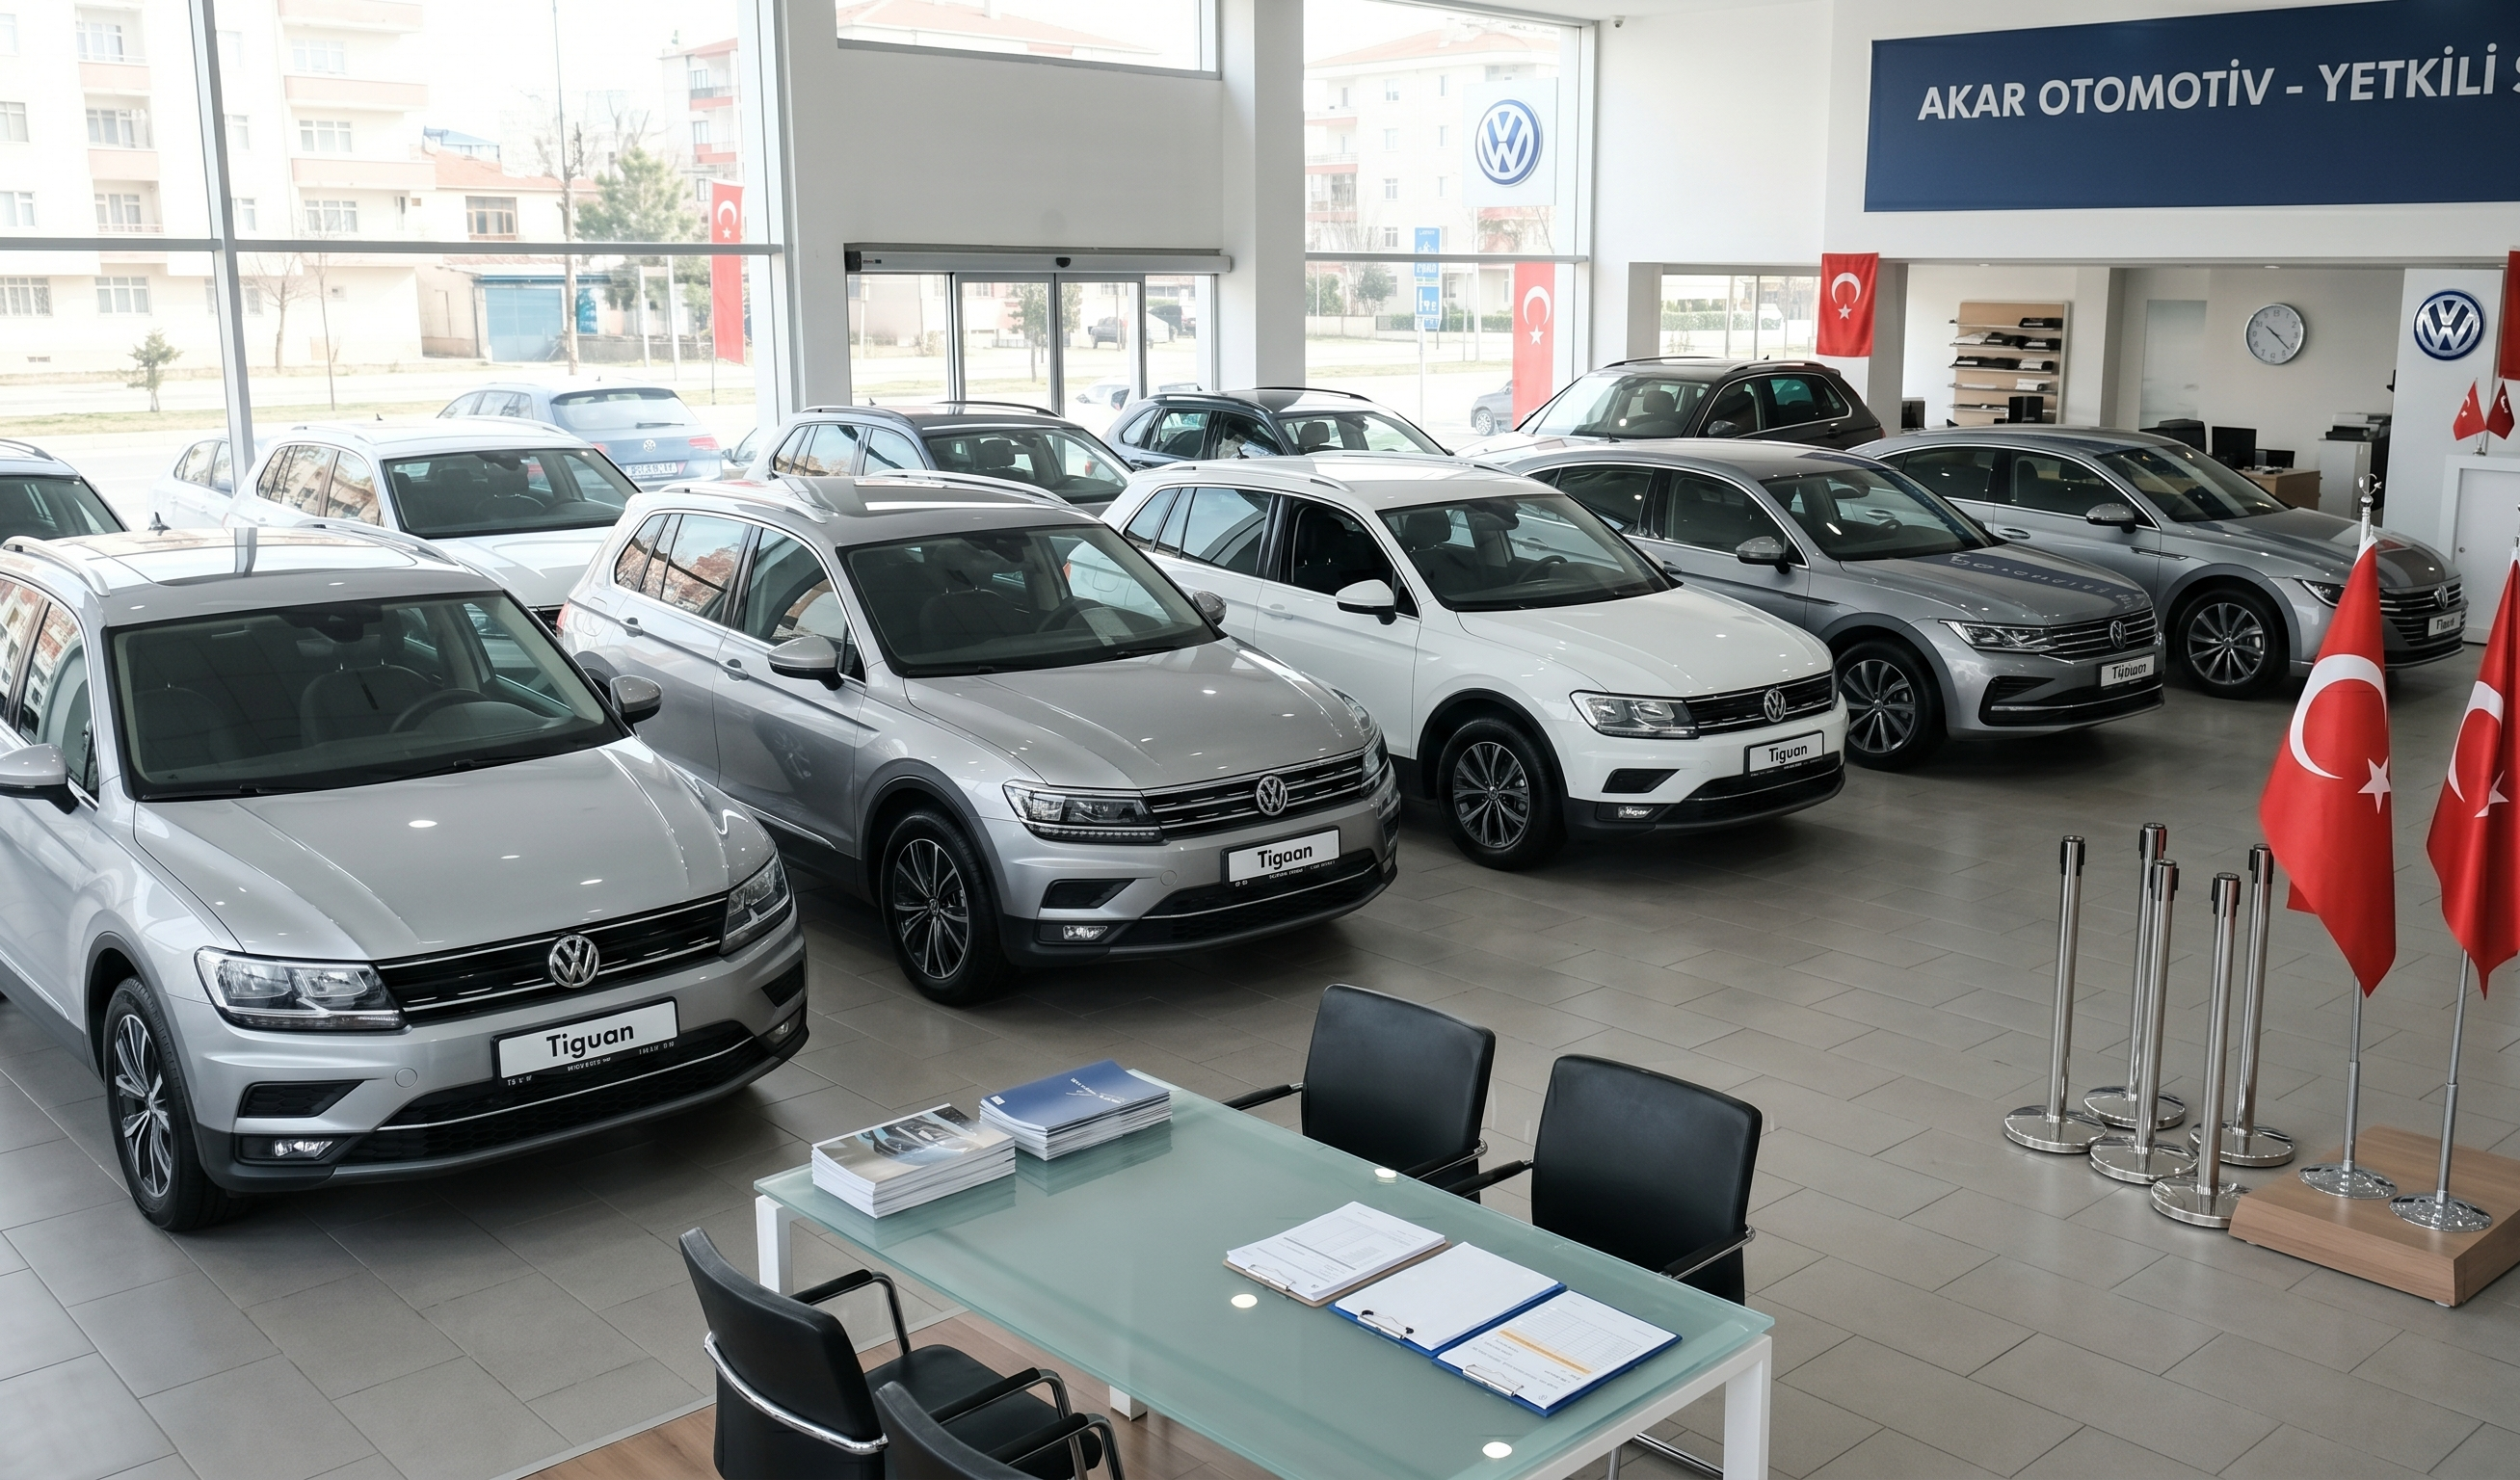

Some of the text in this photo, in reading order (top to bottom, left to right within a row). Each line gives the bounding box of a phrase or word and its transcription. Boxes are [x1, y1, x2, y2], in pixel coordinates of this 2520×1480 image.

[1918, 83, 2025, 120] AKAR
[2039, 59, 2275, 115] OTOMOTİV
[2319, 42, 2497, 101] YETKİLİ
[1475, 99, 1540, 185] VW
[2413, 290, 2484, 360] VW
[1769, 745, 1808, 764] Tiguan
[1257, 775, 1288, 816] VW
[1258, 846, 1313, 870] Tigaan
[549, 935, 600, 989] VW
[546, 1025, 634, 1059] Tiguan
